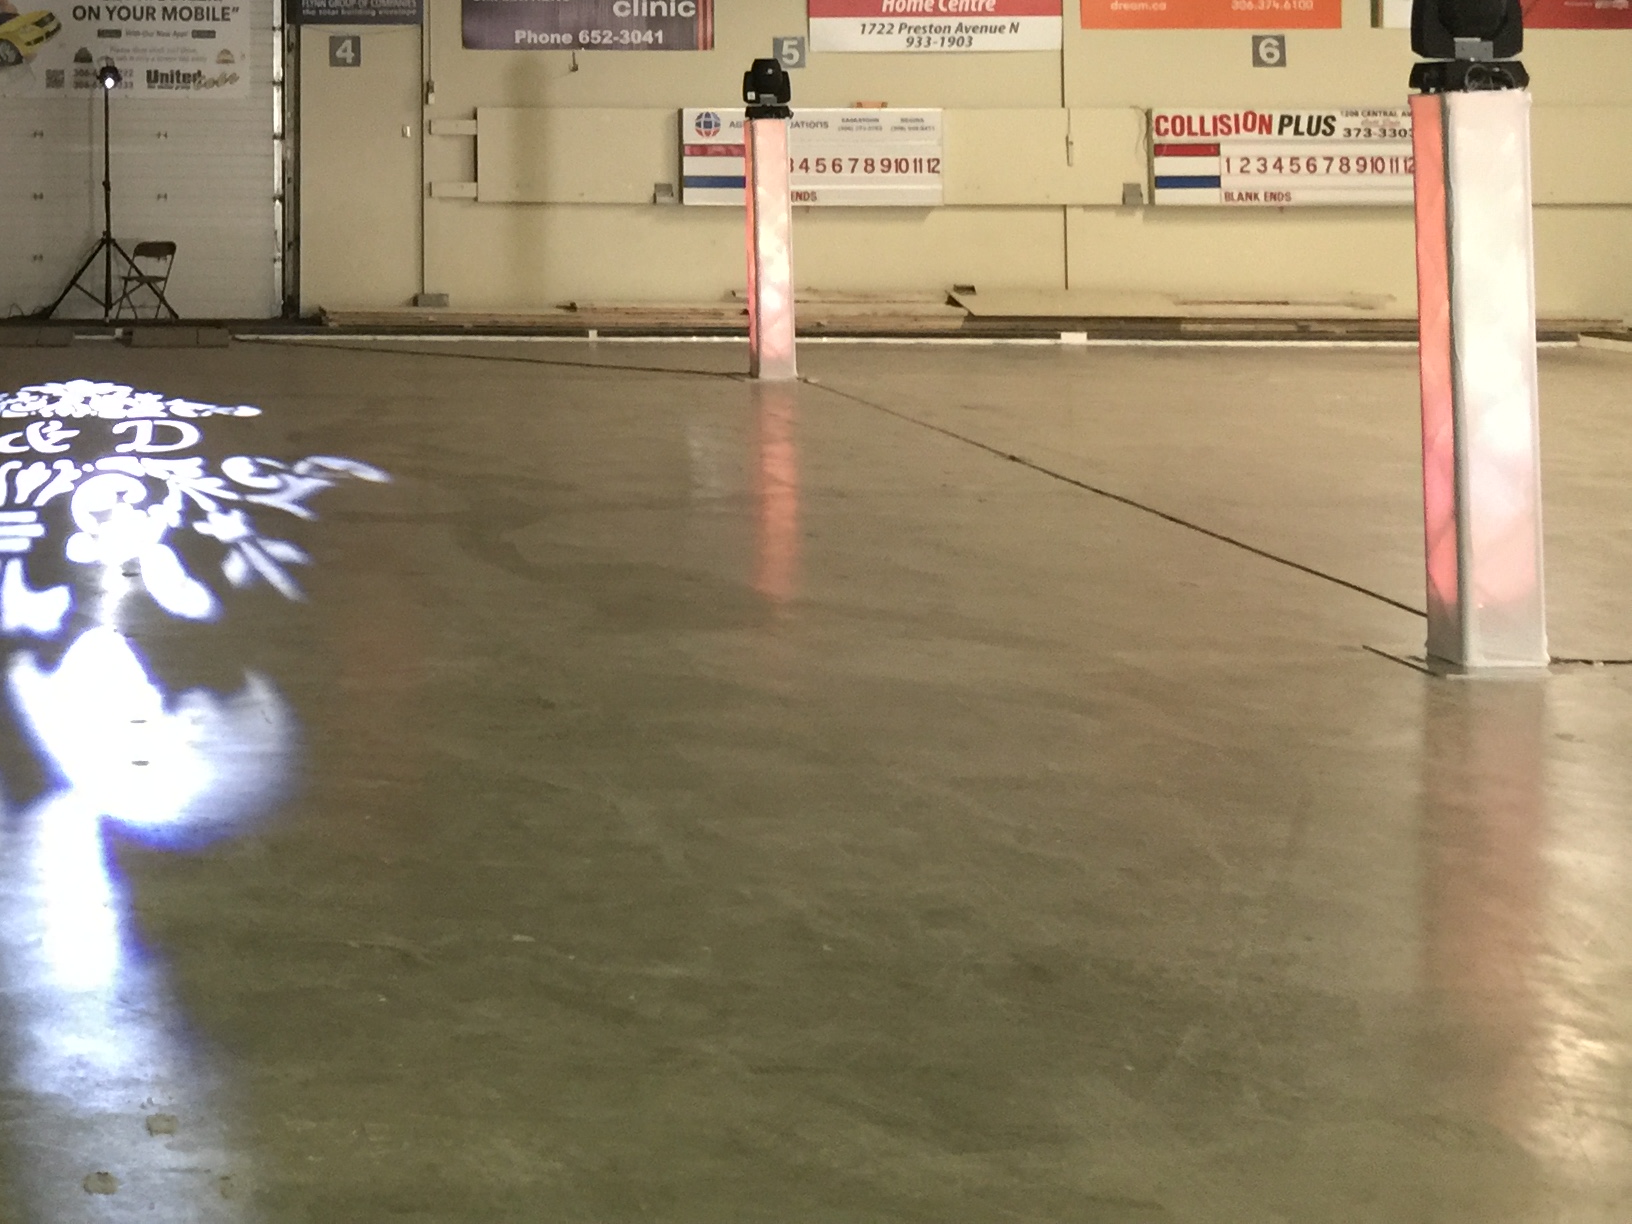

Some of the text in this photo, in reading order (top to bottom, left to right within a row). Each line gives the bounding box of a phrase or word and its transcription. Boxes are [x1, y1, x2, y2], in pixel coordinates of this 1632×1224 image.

[72, 5, 100, 22] ON
[106, 6, 156, 22] YOUR
[1110, 0, 1167, 11] dream.ca
[860, 22, 1020, 35] 1722 Preston Avenue N
[515, 30, 664, 45] Phone 652-3041
[905, 36, 974, 47] 933-1903
[335, 39, 355, 64] 4
[781, 40, 800, 66] 5
[1258, 38, 1281, 64] 6
[146, 69, 202, 84] United
[1154, 110, 1337, 137] COLLISION PLUS
[798, 158, 941, 174] 4 5 6 7 8 9 10 11 12
[1225, 157, 1231, 174] 1
[1239, 157, 1251, 174] 2
[1256, 157, 1268, 174] 3
[1272, 157, 1284, 174] 4
[1289, 157, 1301, 174] 5
[1306, 157, 1317, 174] 6
[1323, 157, 1334, 174] 7
[1339, 157, 1351, 174] 8
[1356, 157, 1367, 174] 9
[1370, 157, 1385, 174] 10
[1389, 157, 1399, 174] 11
[1224, 191, 1292, 202] BLANK ENDS
[112, 418, 202, 454] D
